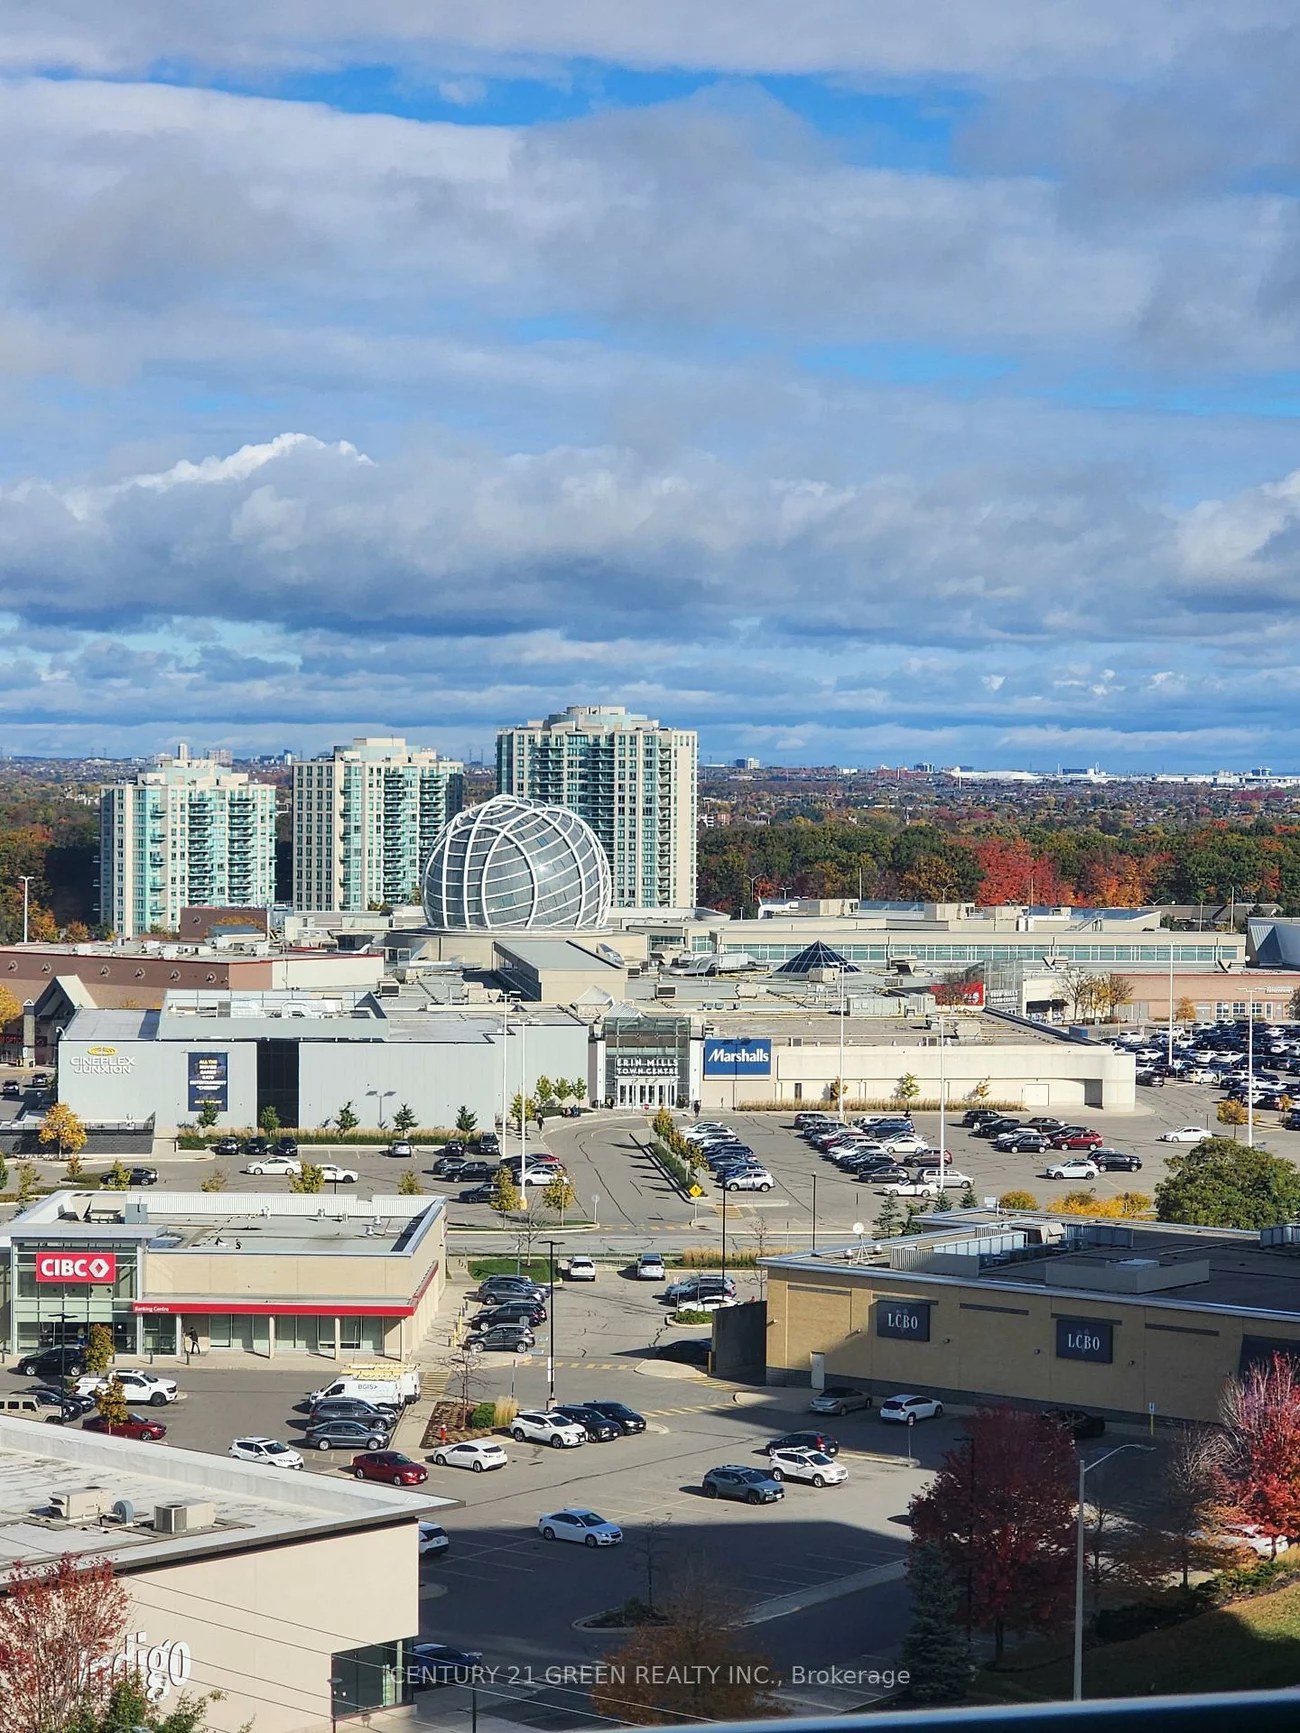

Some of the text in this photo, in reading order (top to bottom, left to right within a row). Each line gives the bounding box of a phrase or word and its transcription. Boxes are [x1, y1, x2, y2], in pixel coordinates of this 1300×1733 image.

[70, 1056, 136, 1067] CINEPLEX
[708, 1049, 769, 1063] Marshalls
[616, 1058, 679, 1067] ERIN MILLS
[74, 1065, 131, 1075] JUNXION
[616, 1067, 644, 1075] TOWN
[40, 1258, 88, 1277] CIBC
[887, 1313, 919, 1330] LCBO
[1067, 1333, 1101, 1351] LCBO
